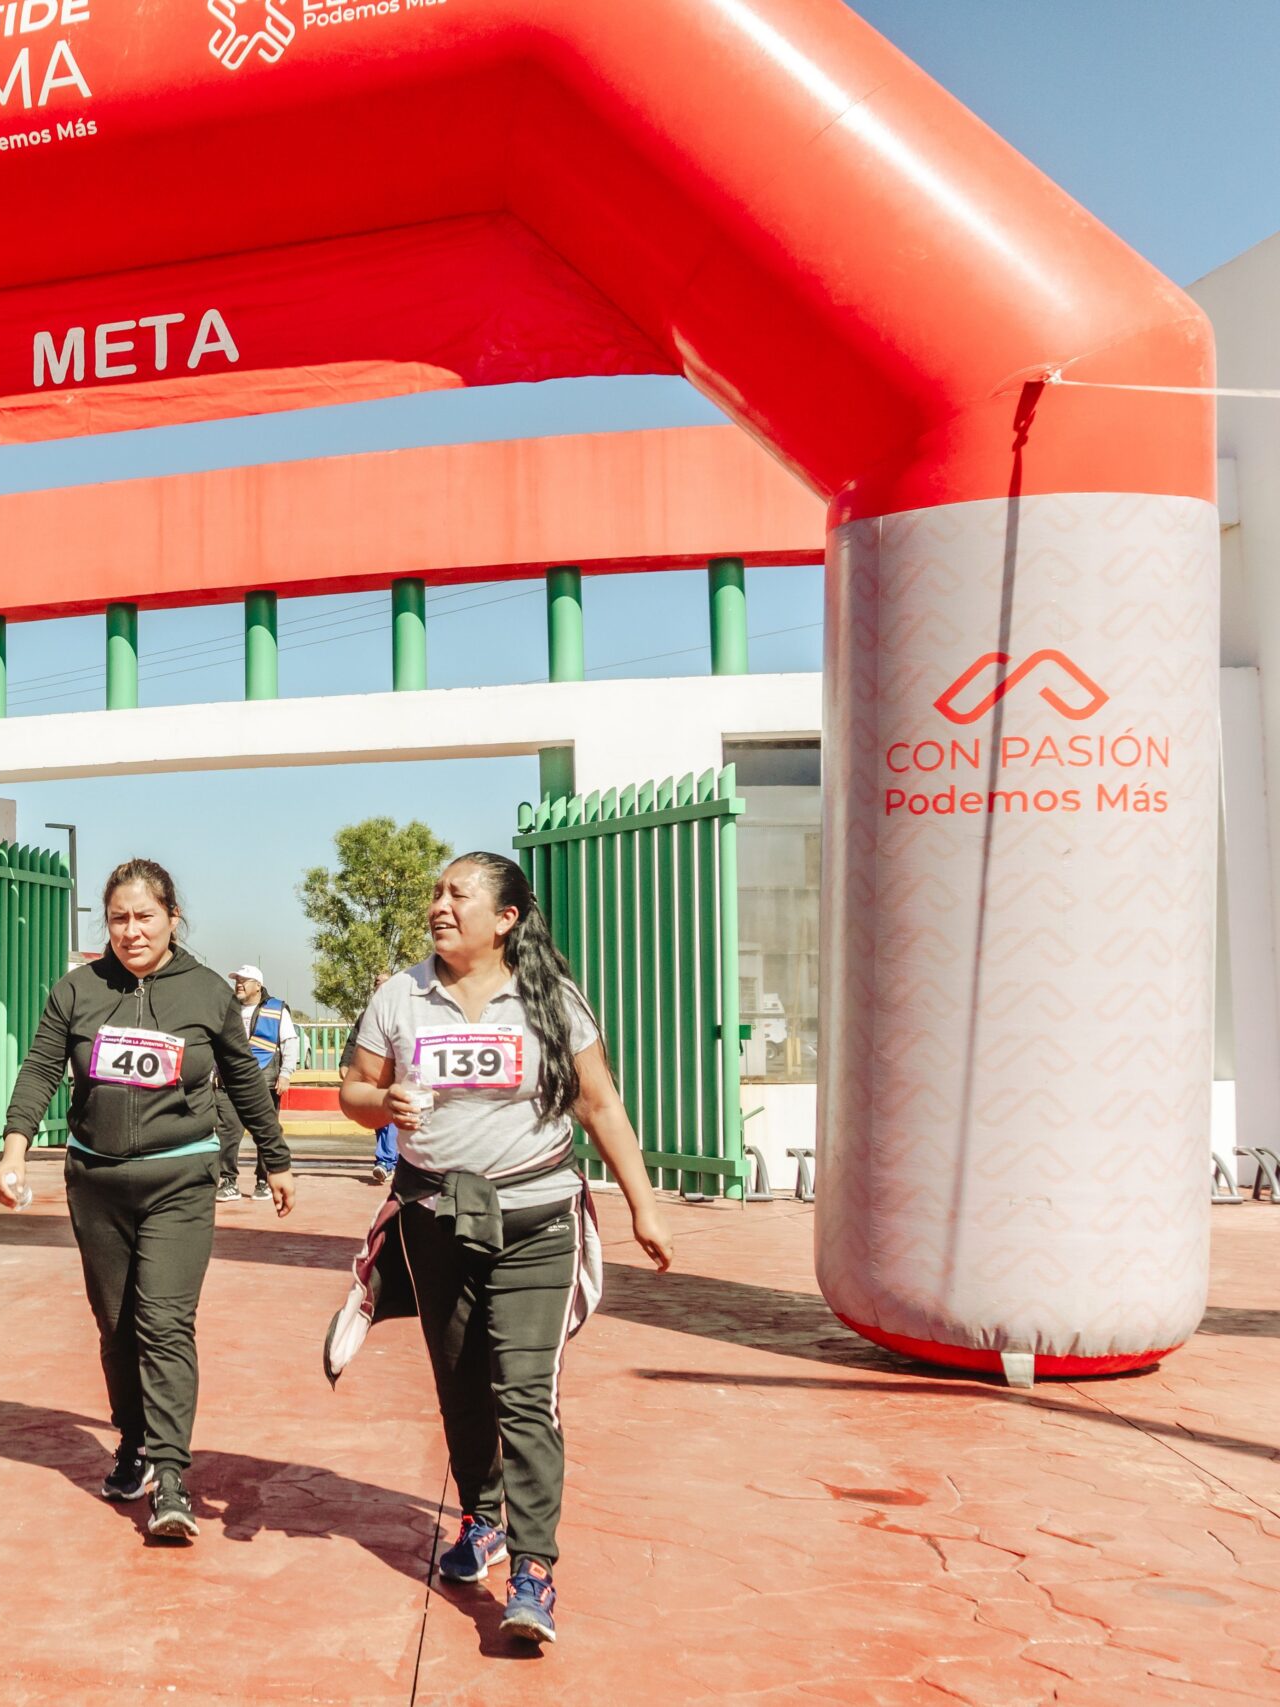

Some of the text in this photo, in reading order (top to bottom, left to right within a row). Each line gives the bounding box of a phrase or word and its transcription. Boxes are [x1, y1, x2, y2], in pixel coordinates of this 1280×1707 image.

[303, 0, 400, 30] Podemos
[56, 118, 98, 141] Más
[33, 308, 239, 387] META
[886, 728, 1170, 773] CON PASIÓN
[885, 782, 1169, 816] Podemos Más
[112, 1050, 159, 1078] 40
[433, 1048, 502, 1077] 139
